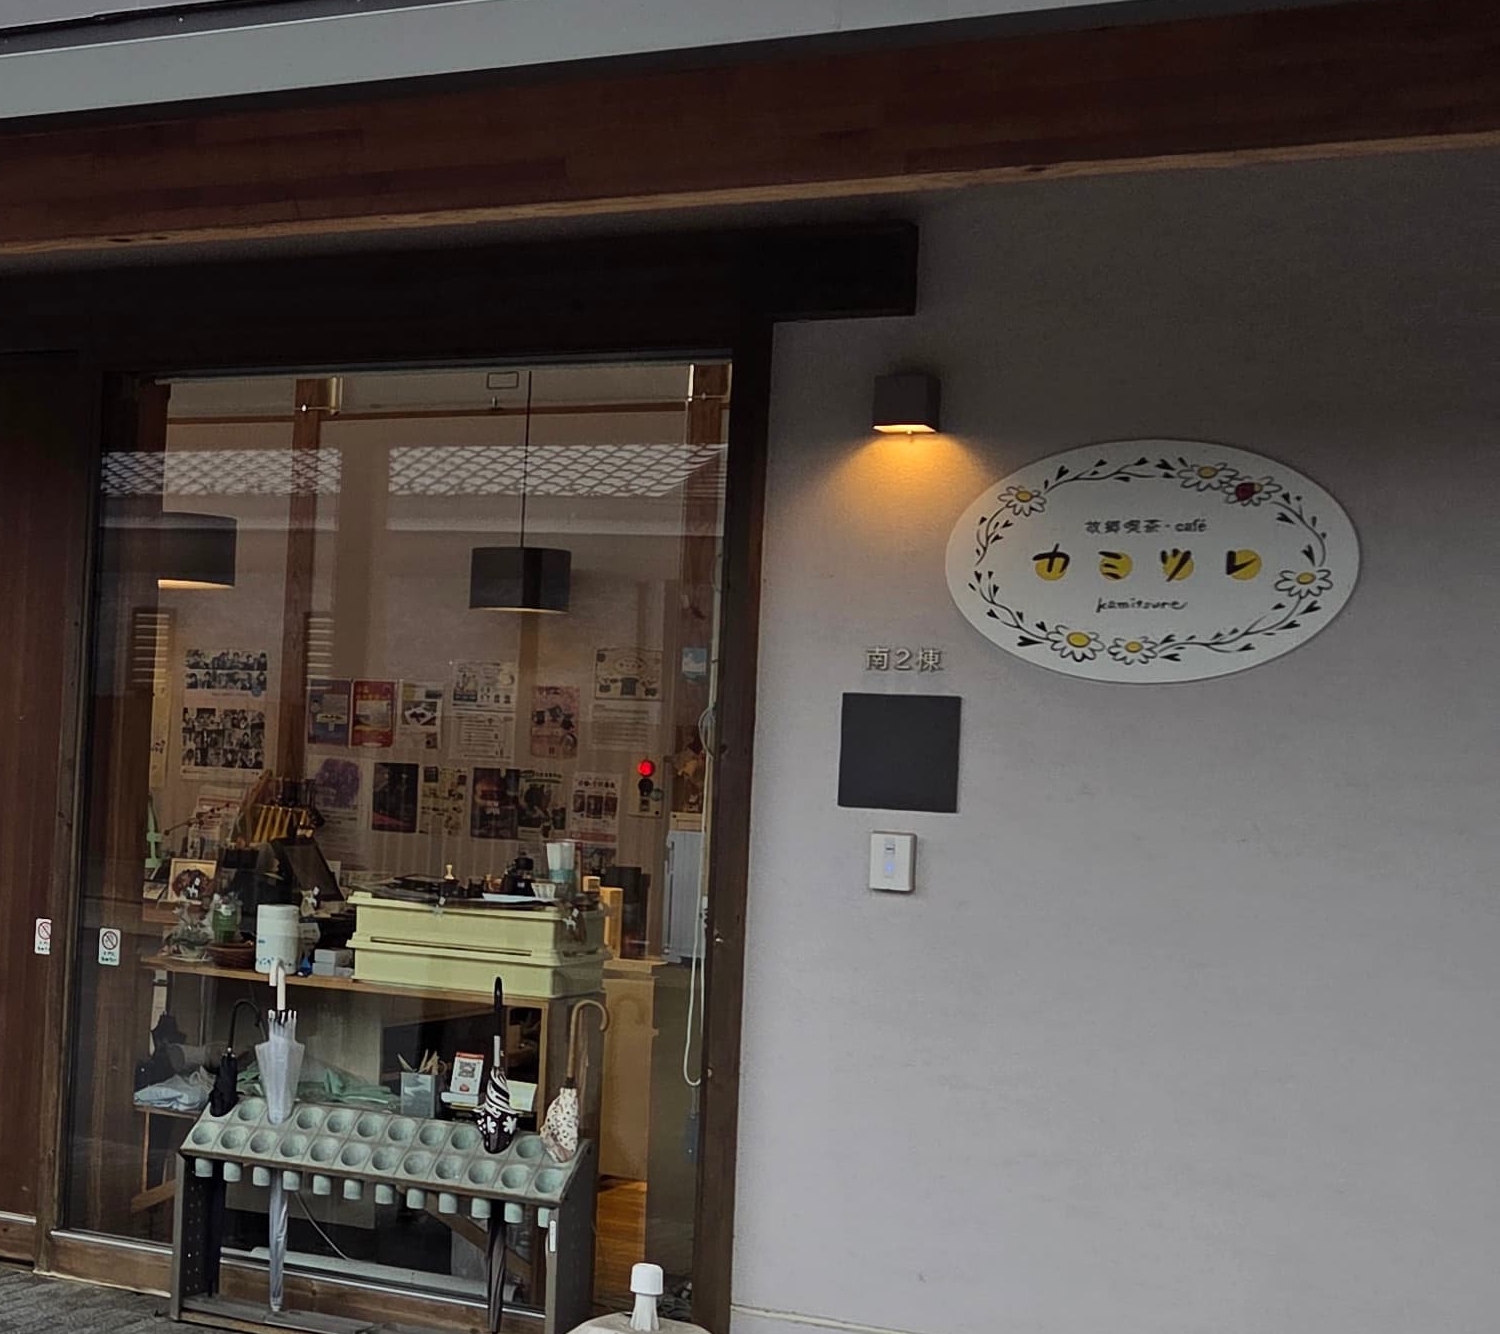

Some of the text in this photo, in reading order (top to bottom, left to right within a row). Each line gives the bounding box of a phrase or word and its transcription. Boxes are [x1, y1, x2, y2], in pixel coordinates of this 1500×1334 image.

[1032, 543, 1258, 582] カミツレ
[866, 647, 945, 672] 南2棟
